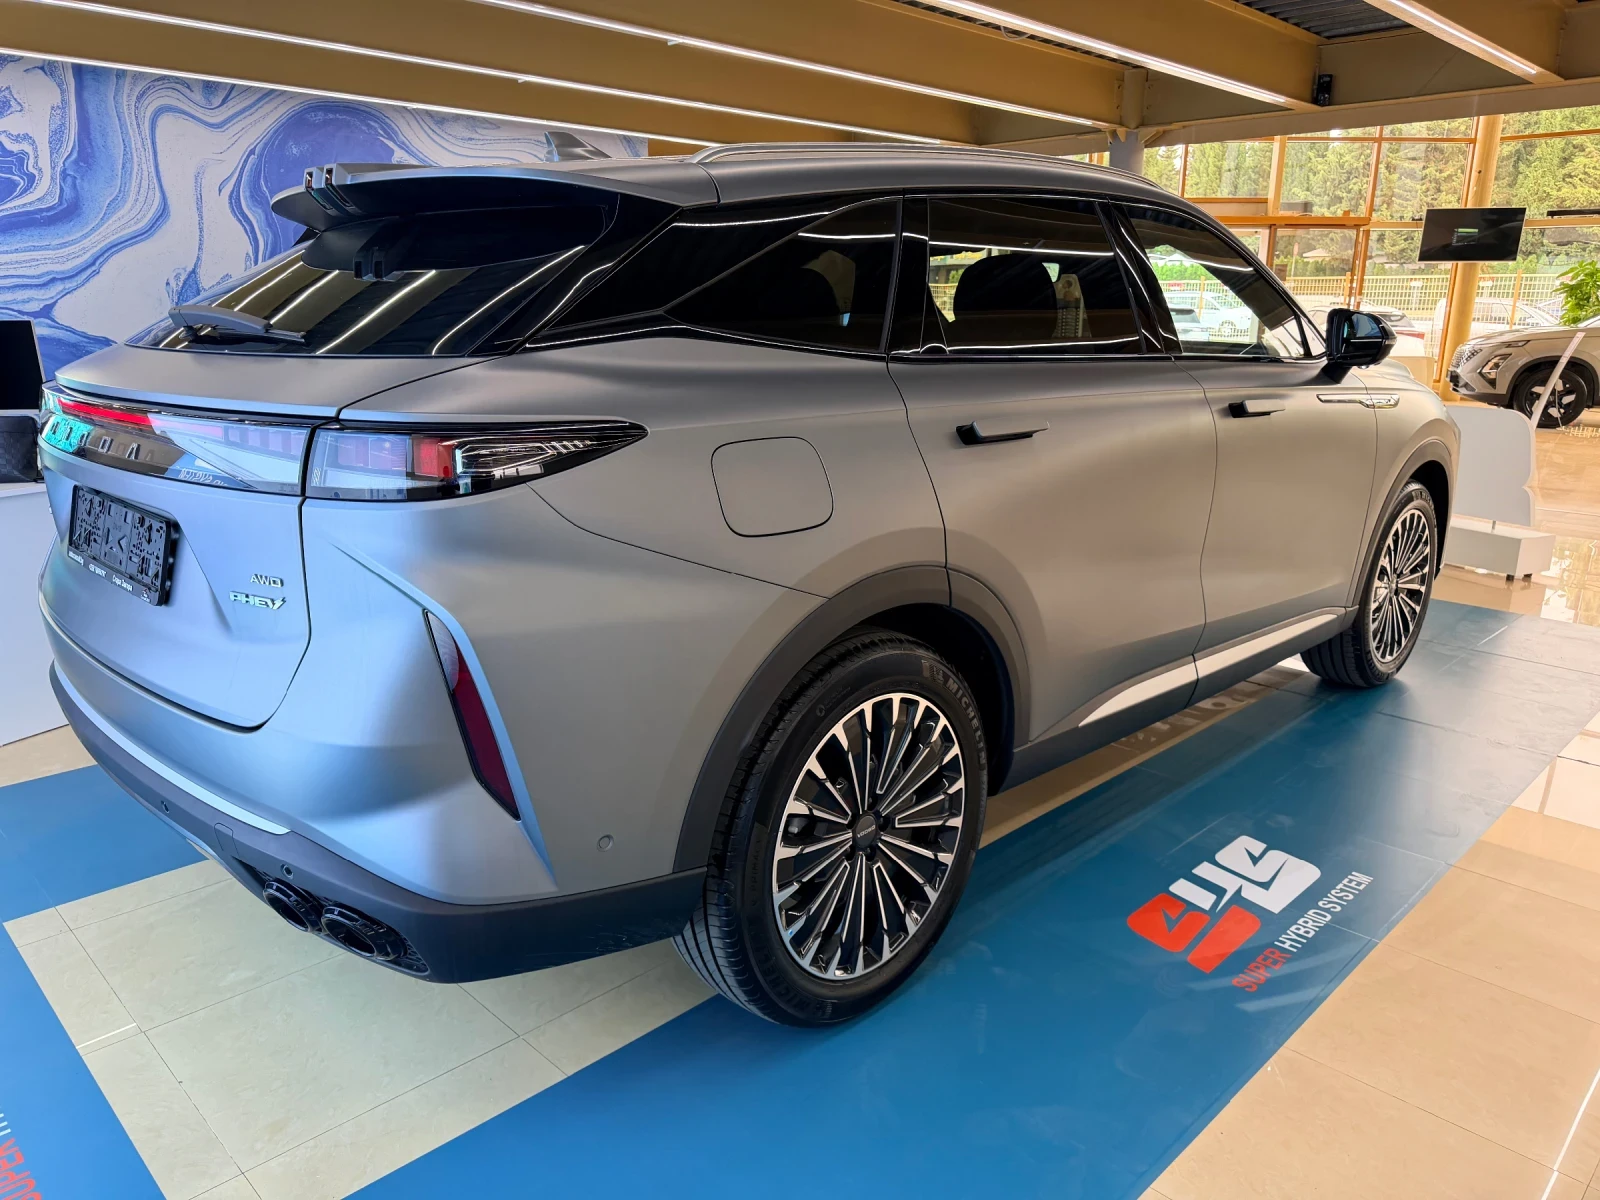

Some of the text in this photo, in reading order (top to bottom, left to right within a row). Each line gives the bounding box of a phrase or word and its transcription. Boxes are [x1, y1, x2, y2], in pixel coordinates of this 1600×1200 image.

[229, 591, 286, 610] PHEV
[250, 574, 284, 588] AWD
[945, 678, 987, 764] MICHELIN
[1232, 872, 1374, 993] SUPER HYBRID SYSTEM
